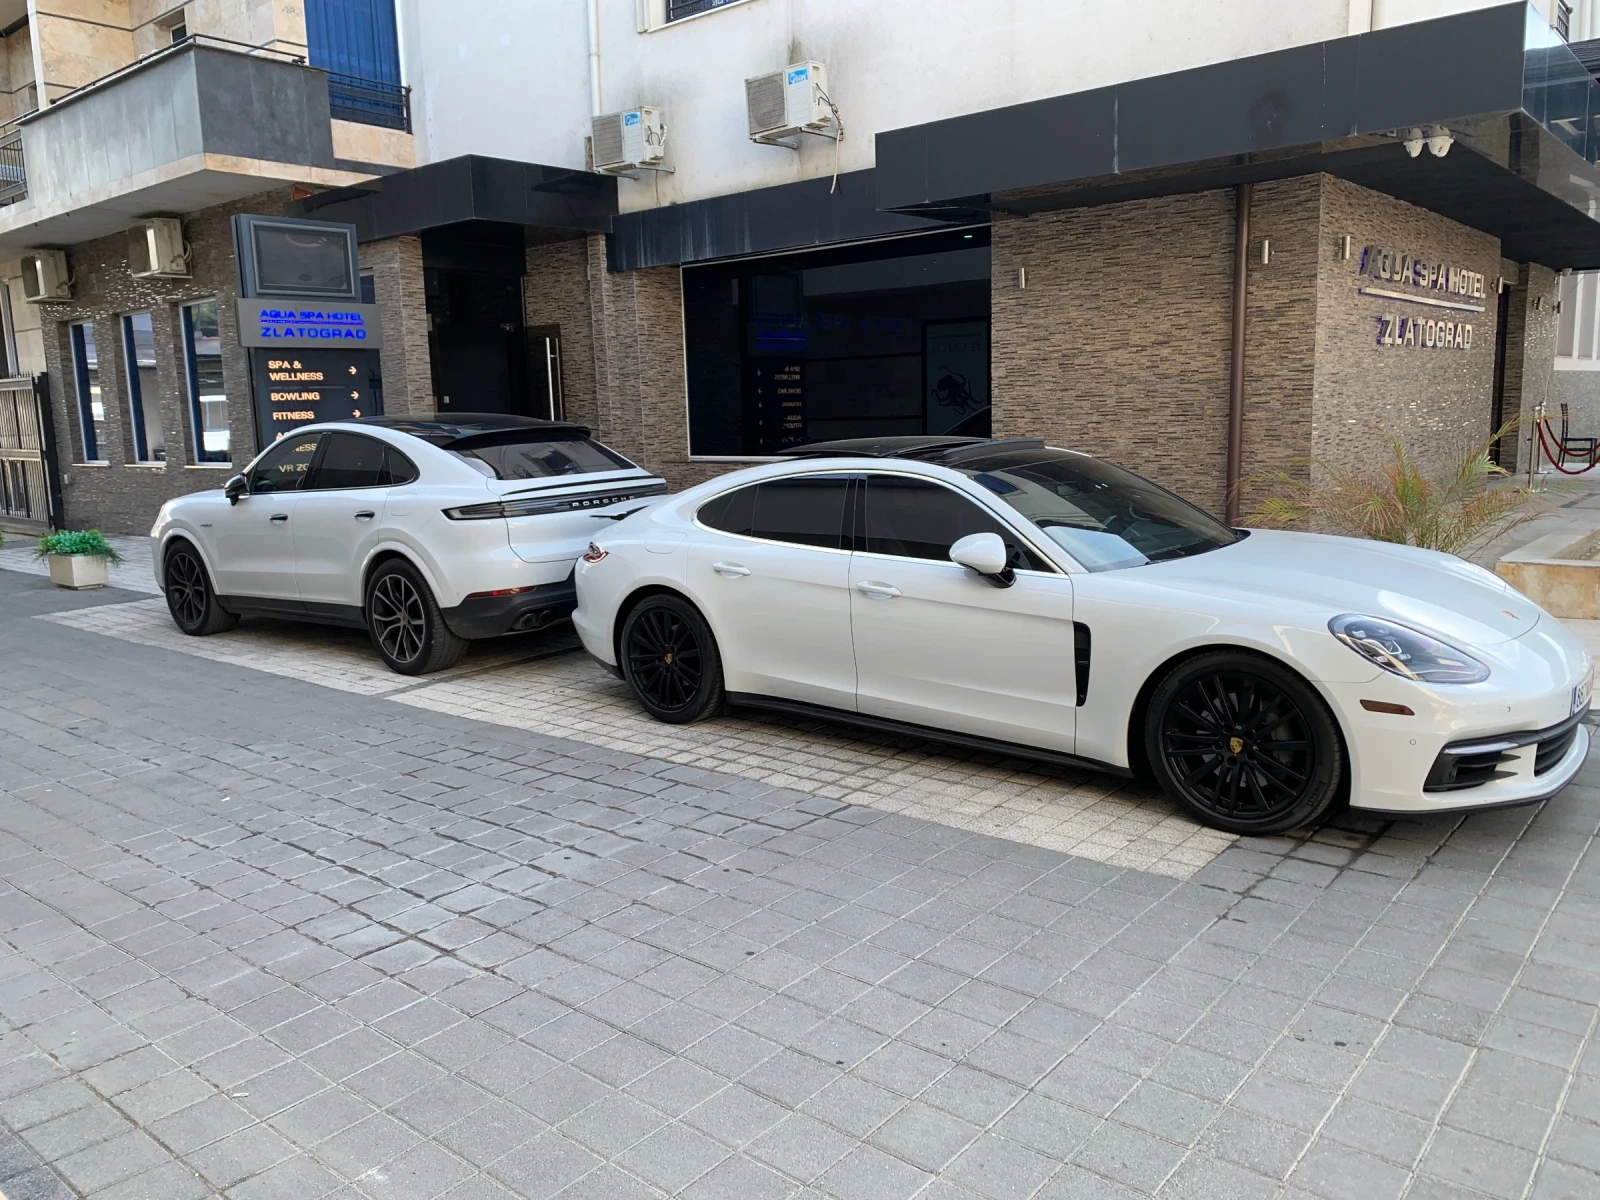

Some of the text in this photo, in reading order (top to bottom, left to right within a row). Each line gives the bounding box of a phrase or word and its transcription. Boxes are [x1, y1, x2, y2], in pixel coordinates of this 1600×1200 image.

[1360, 246, 1486, 299] AQUA SPA HOTEL
[260, 309, 364, 322] AQUA SPA HOTEL
[261, 326, 367, 340] ZLATOGRAD
[1379, 315, 1473, 349] ZLATOGRAD
[268, 360, 302, 369] SPA &
[269, 371, 324, 381] WELLNESS
[270, 391, 320, 401] BOWLING
[272, 411, 315, 421] FITNESS
